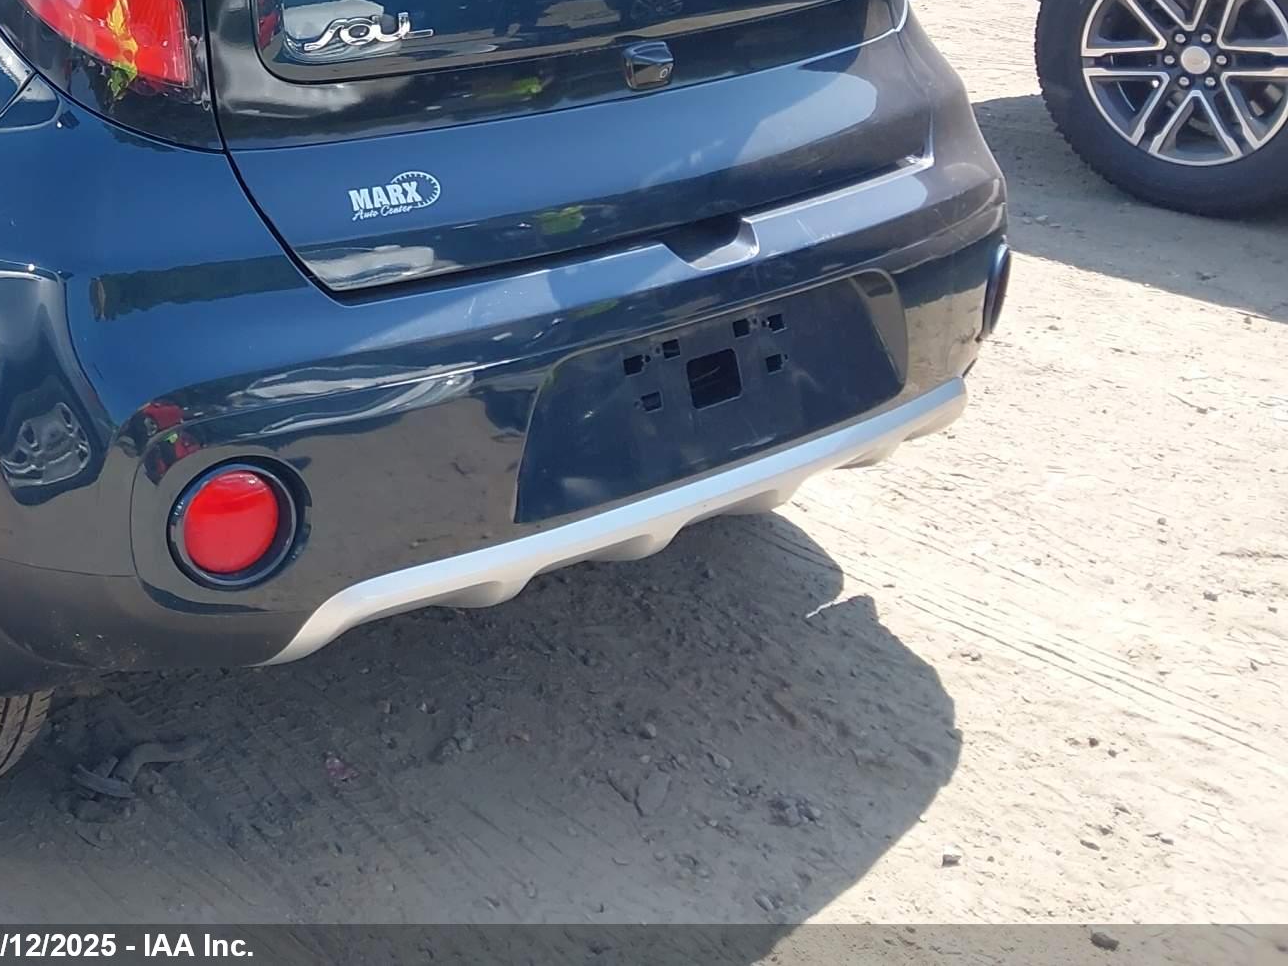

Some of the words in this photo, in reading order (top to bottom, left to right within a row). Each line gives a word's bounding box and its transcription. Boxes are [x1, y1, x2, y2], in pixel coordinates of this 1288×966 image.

[348, 181, 422, 212] MARX
[352, 208, 379, 221] Auto
[380, 204, 414, 217] Center
